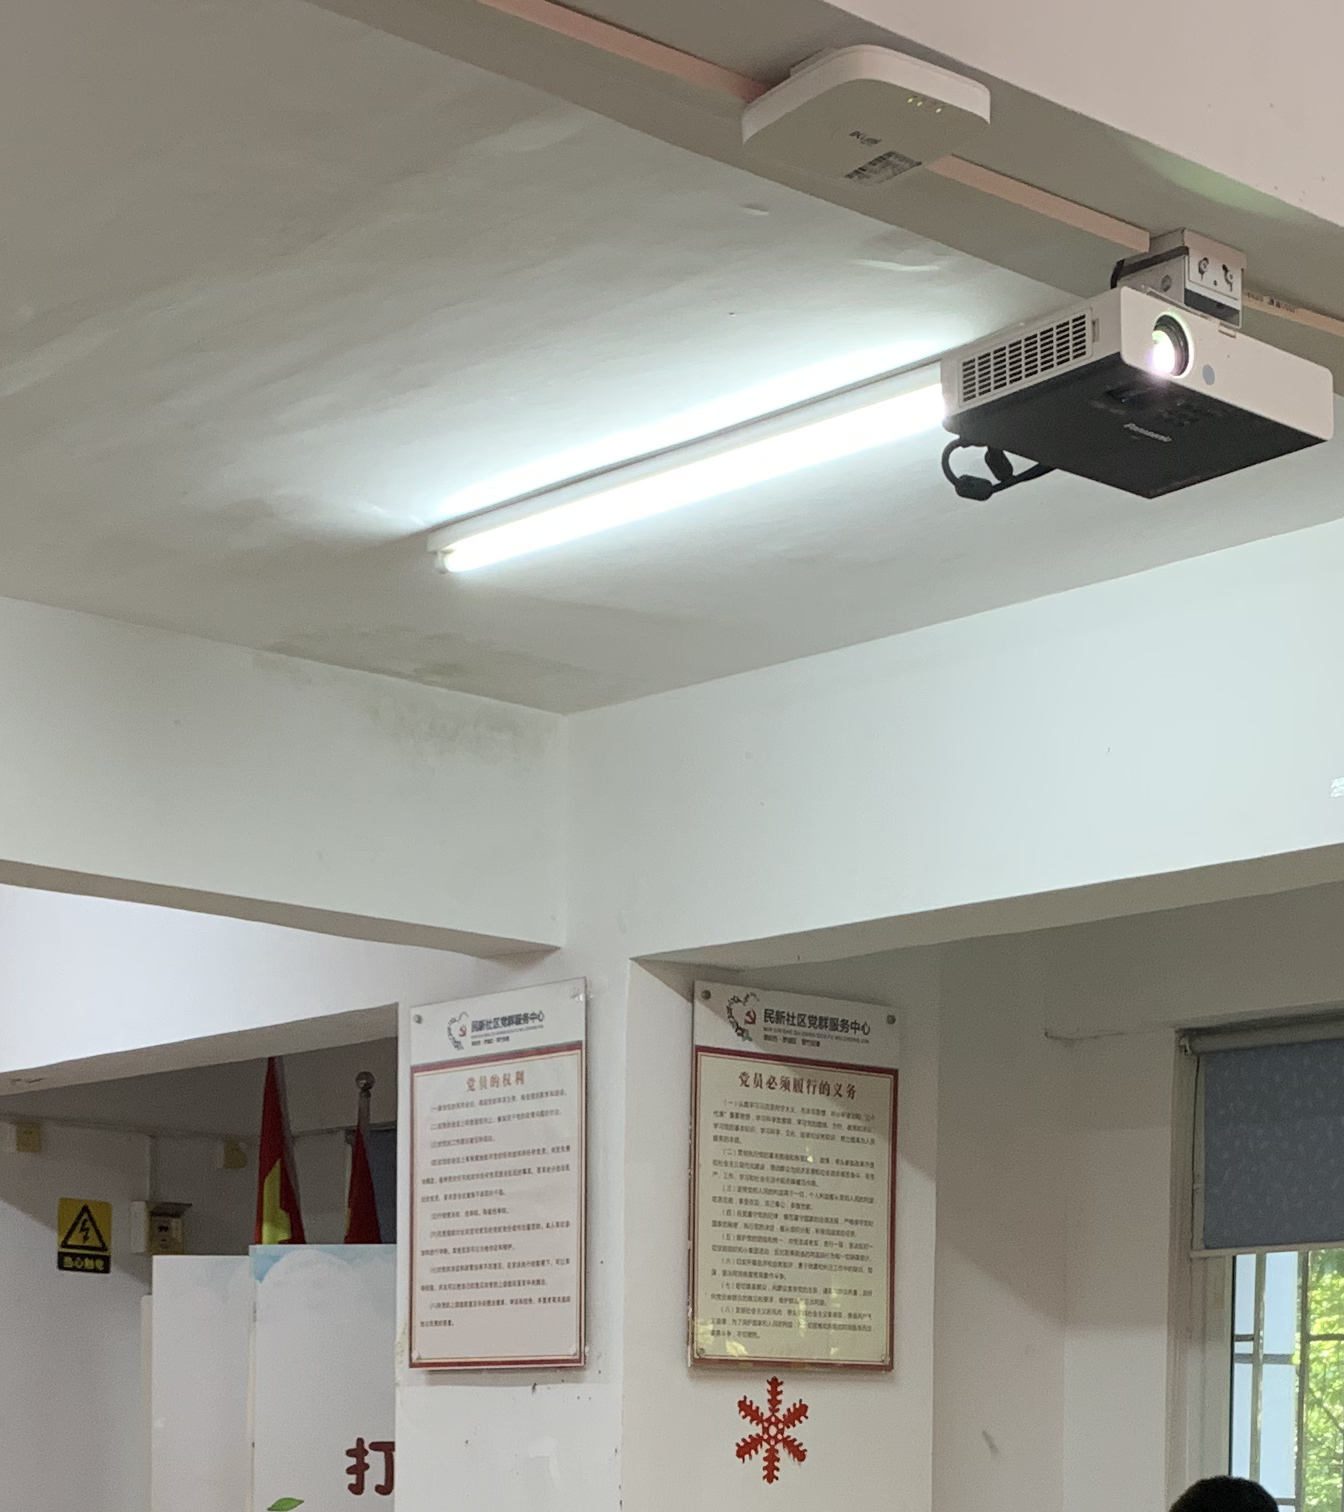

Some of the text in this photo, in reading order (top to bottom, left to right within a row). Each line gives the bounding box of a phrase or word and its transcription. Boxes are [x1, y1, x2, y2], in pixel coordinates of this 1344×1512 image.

[763, 1007, 871, 1036] 民新社区党群服务中心
[466, 1070, 526, 1092] 党员的权利
[738, 1071, 857, 1100] 党员必须履行的义务
